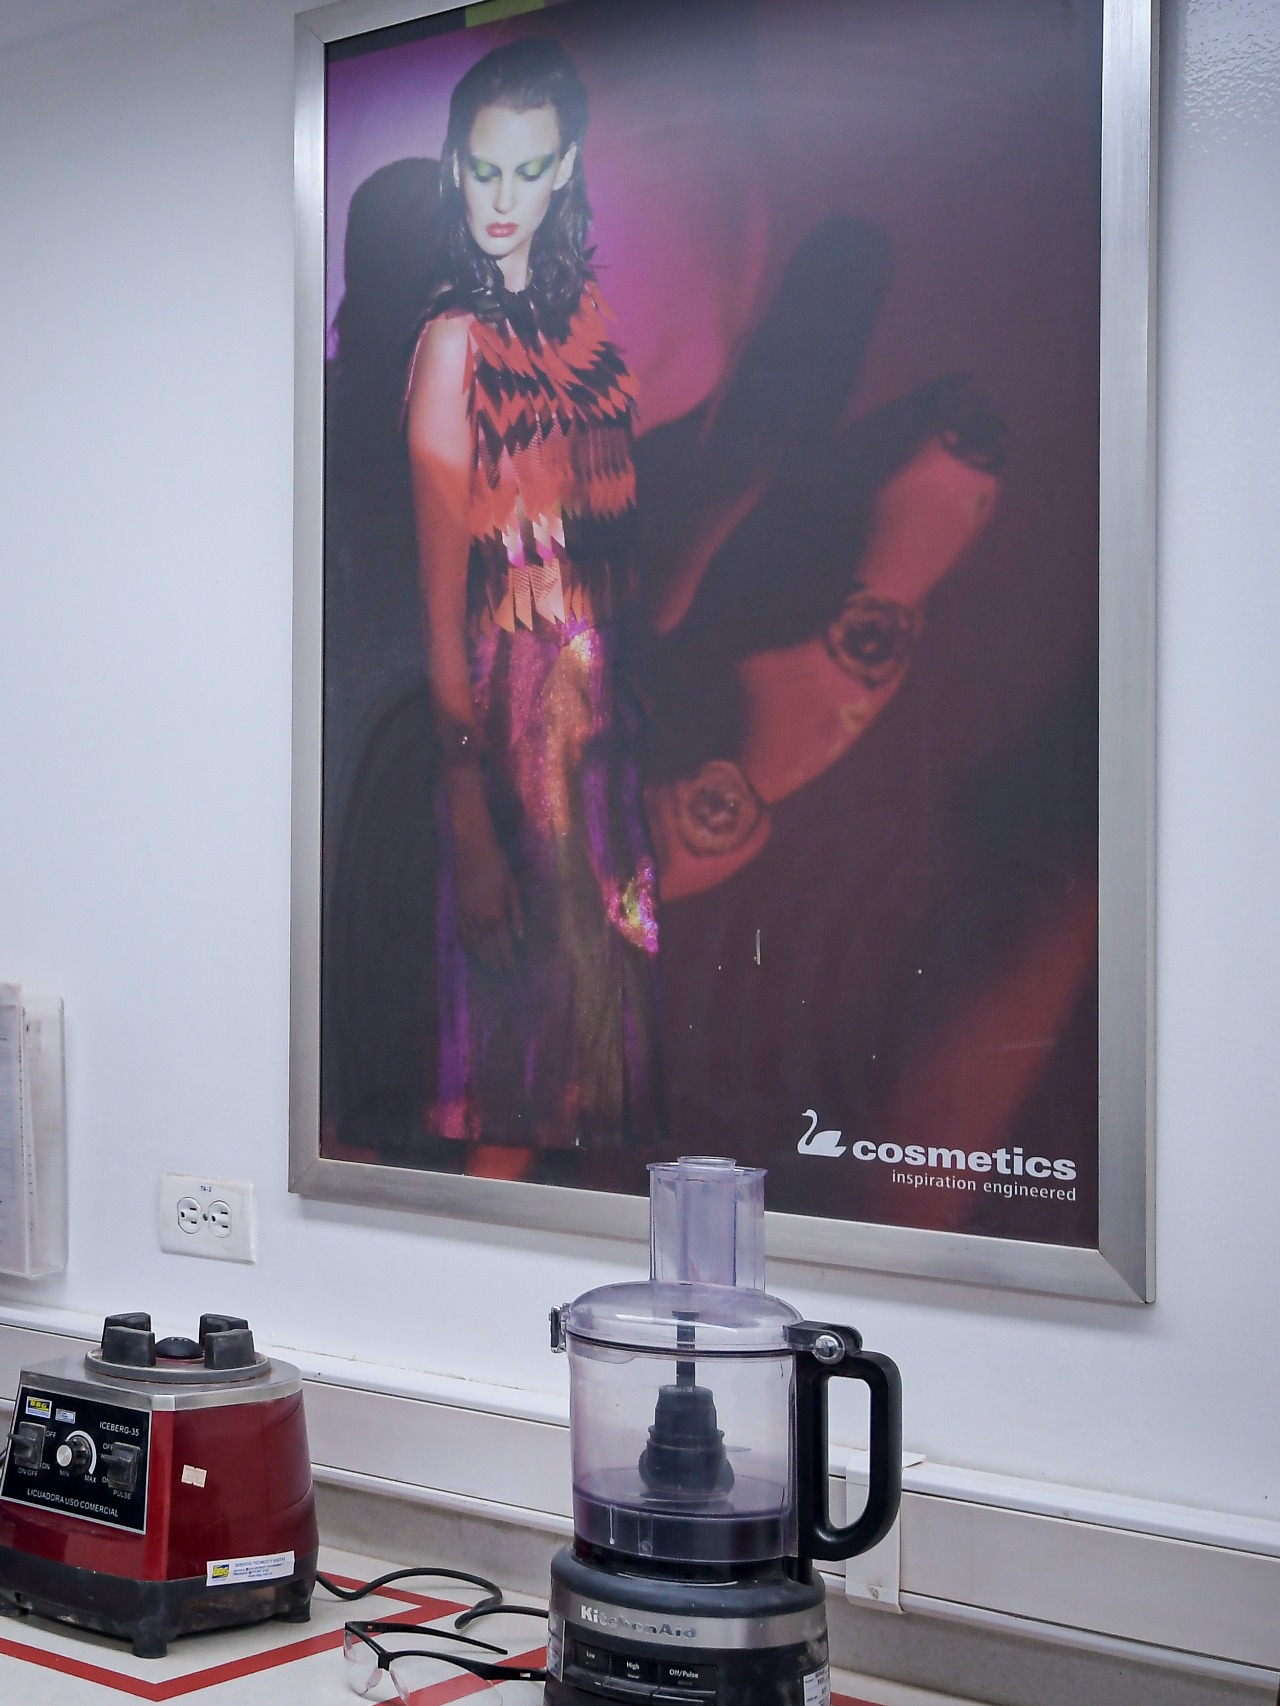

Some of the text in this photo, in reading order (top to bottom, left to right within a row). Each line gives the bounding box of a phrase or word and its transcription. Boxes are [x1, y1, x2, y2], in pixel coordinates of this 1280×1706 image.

[852, 1139, 1077, 1181] cosmetics
[891, 1169, 1076, 1202] inspiration engineered
[46, 1430, 57, 1438] OFF
[99, 1421, 140, 1437] ICEBERG-35
[84, 1474, 97, 1484] MAX
[112, 1489, 132, 1500] PULSE
[27, 1487, 119, 1517] LICUADORA USO COMERCIAL
[581, 1605, 697, 1638] KitchenAid
[626, 1660, 640, 1671] High
[669, 1668, 699, 1679] Off/Pulse
